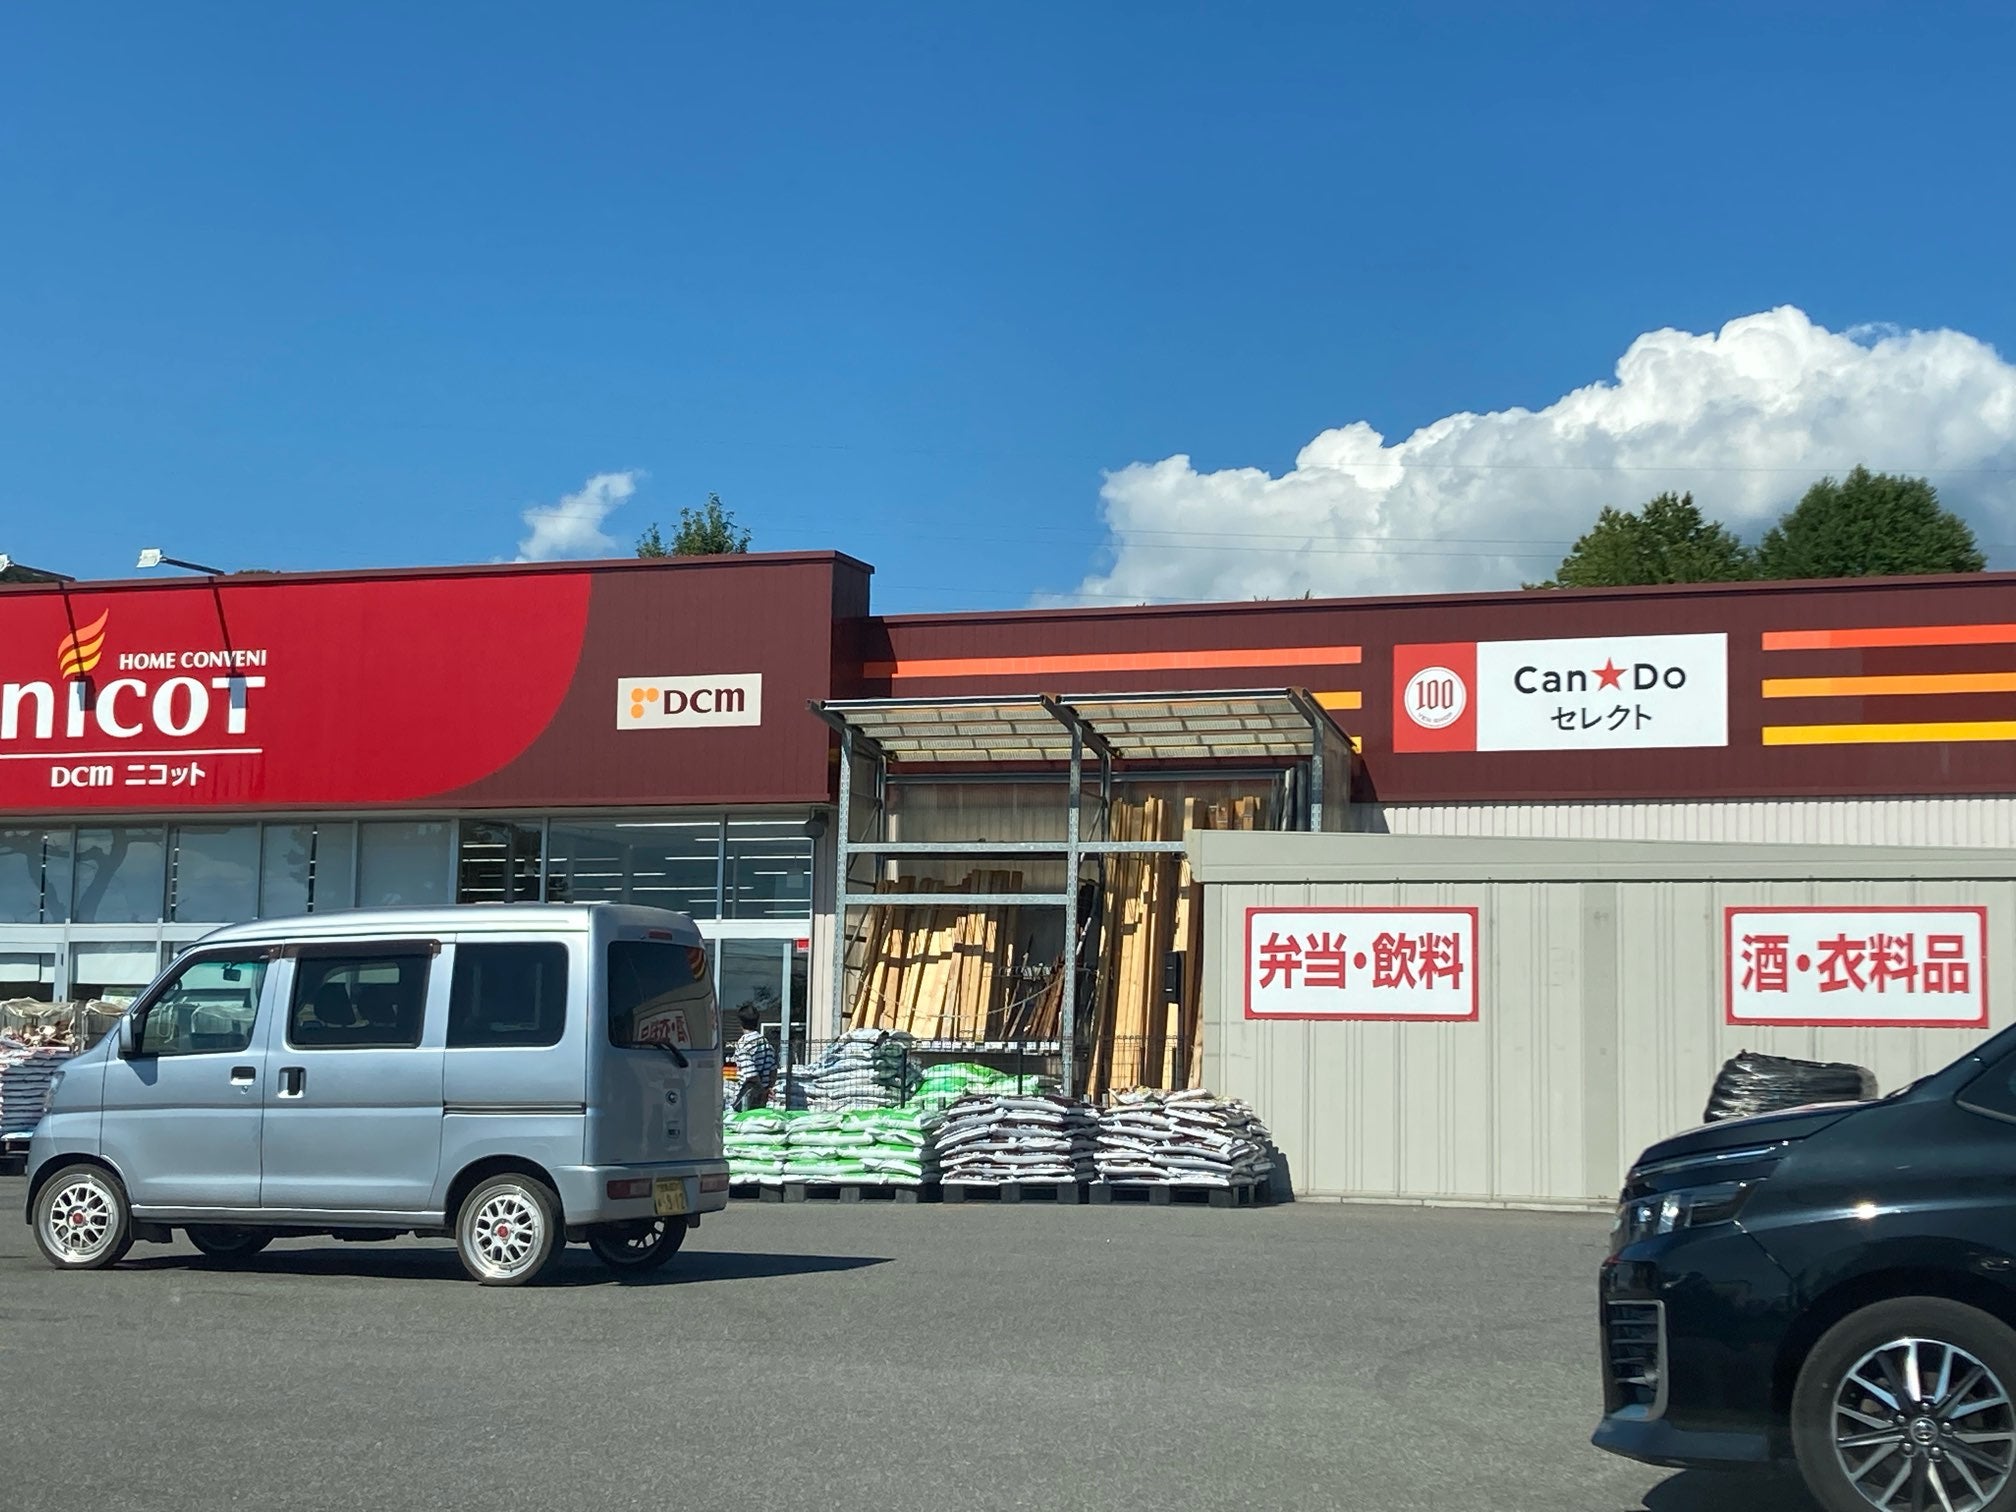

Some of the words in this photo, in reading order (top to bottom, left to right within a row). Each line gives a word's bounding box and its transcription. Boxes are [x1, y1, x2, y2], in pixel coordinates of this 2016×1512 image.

[119, 652, 176, 671] HOME
[180, 649, 267, 669] CONVENI
[1416, 678, 1453, 710] 100
[1514, 666, 1587, 694] Can
[1634, 663, 1686, 690] Do
[1551, 704, 1652, 731] セレクト
[125, 761, 206, 787] ニコット
[1259, 932, 1464, 990] 弁当・飲料
[1741, 932, 1970, 994] 酒・衣料品
